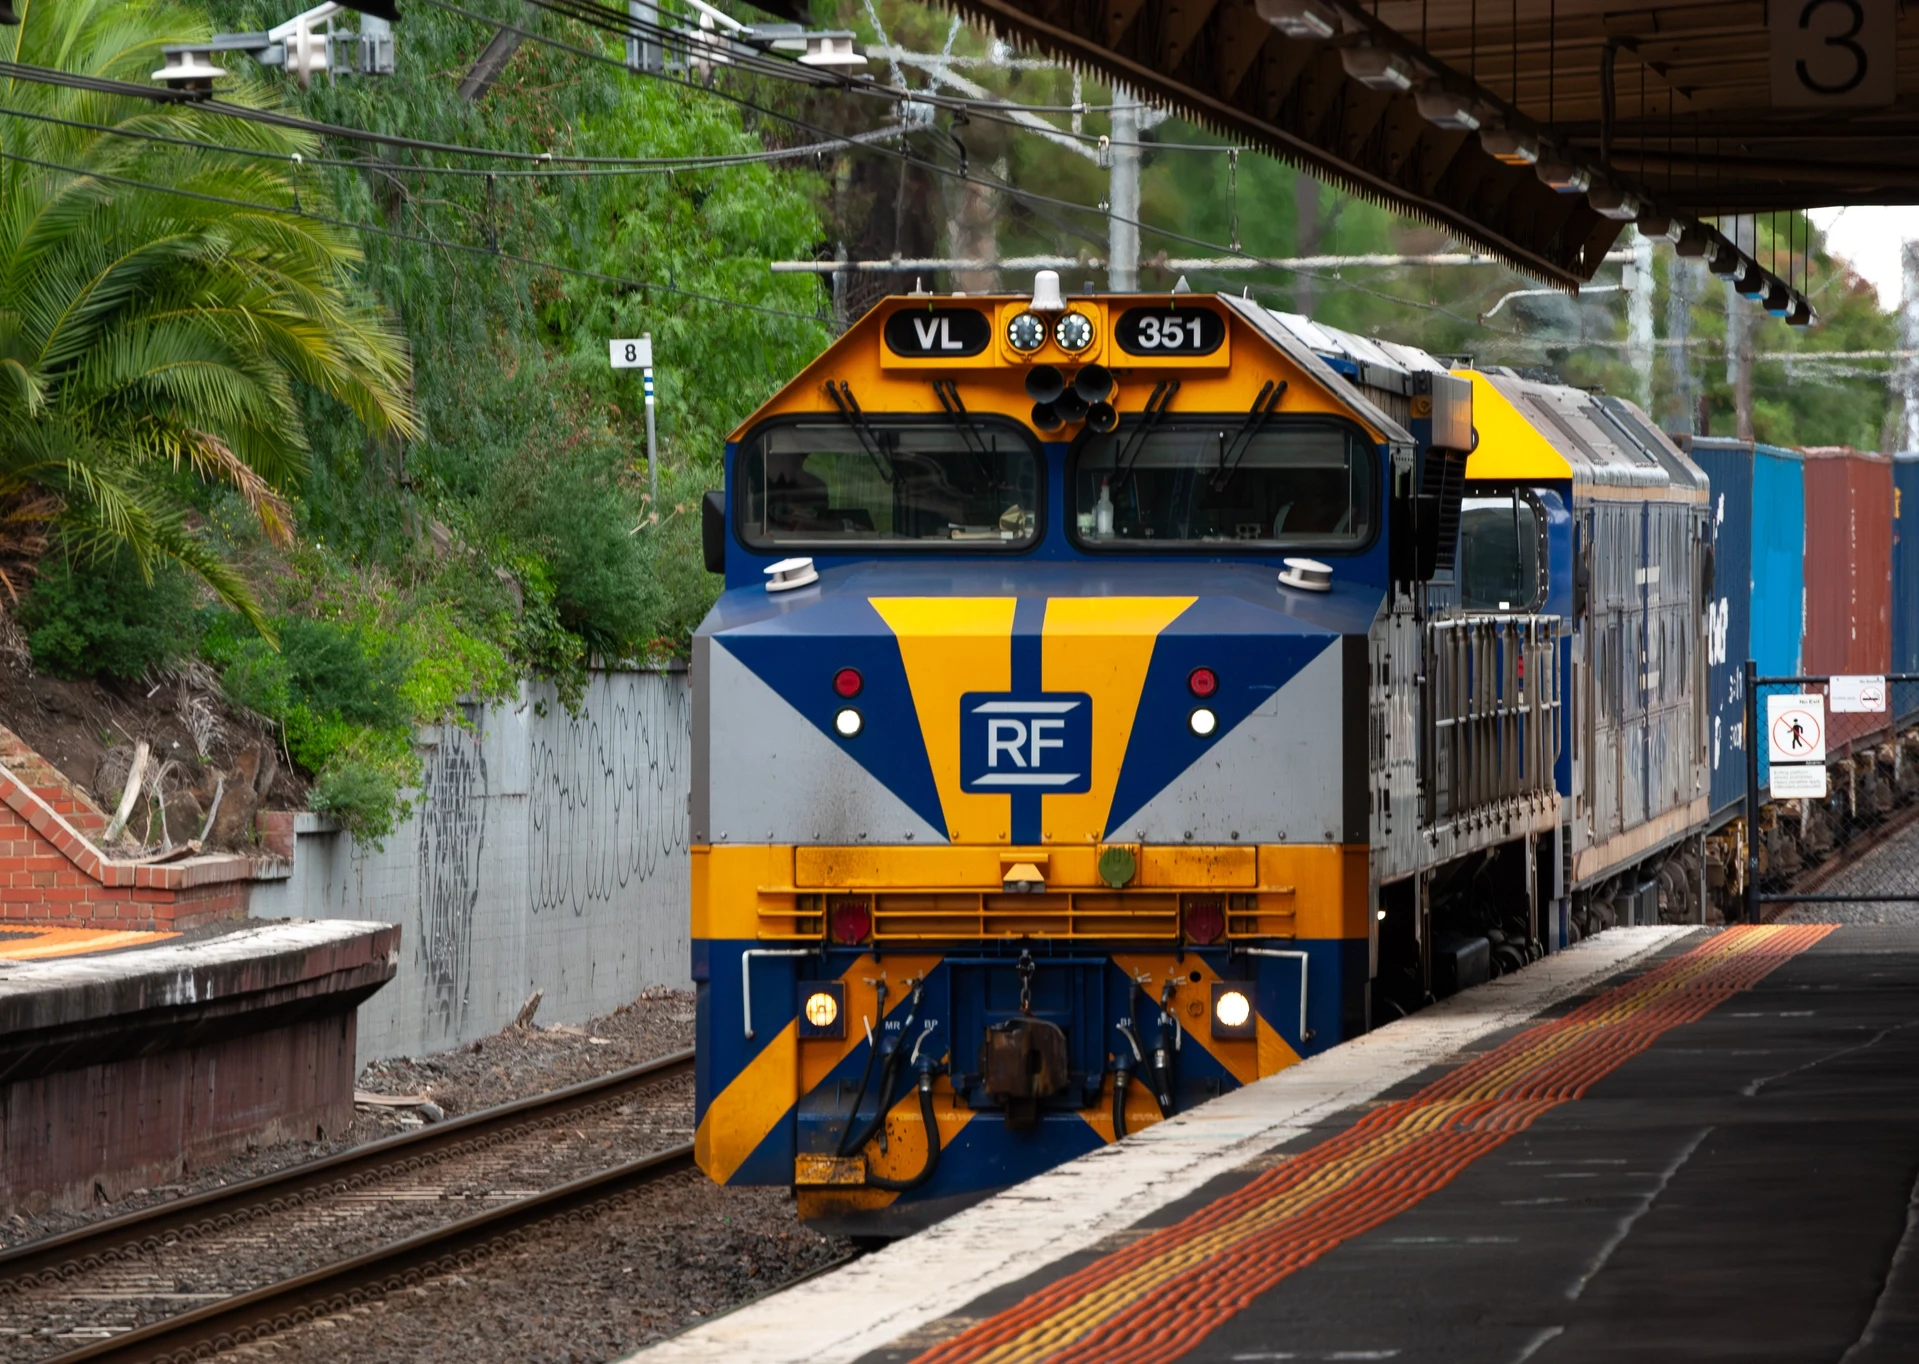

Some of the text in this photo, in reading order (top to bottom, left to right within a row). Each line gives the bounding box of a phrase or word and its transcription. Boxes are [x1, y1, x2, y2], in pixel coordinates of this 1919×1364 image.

[1796, 0, 1868, 94] 3
[913, 317, 963, 349] VL
[1138, 316, 1201, 349] 351
[624, 343, 637, 362] 8
[988, 719, 1065, 767] RF
[885, 1020, 901, 1030] MR
